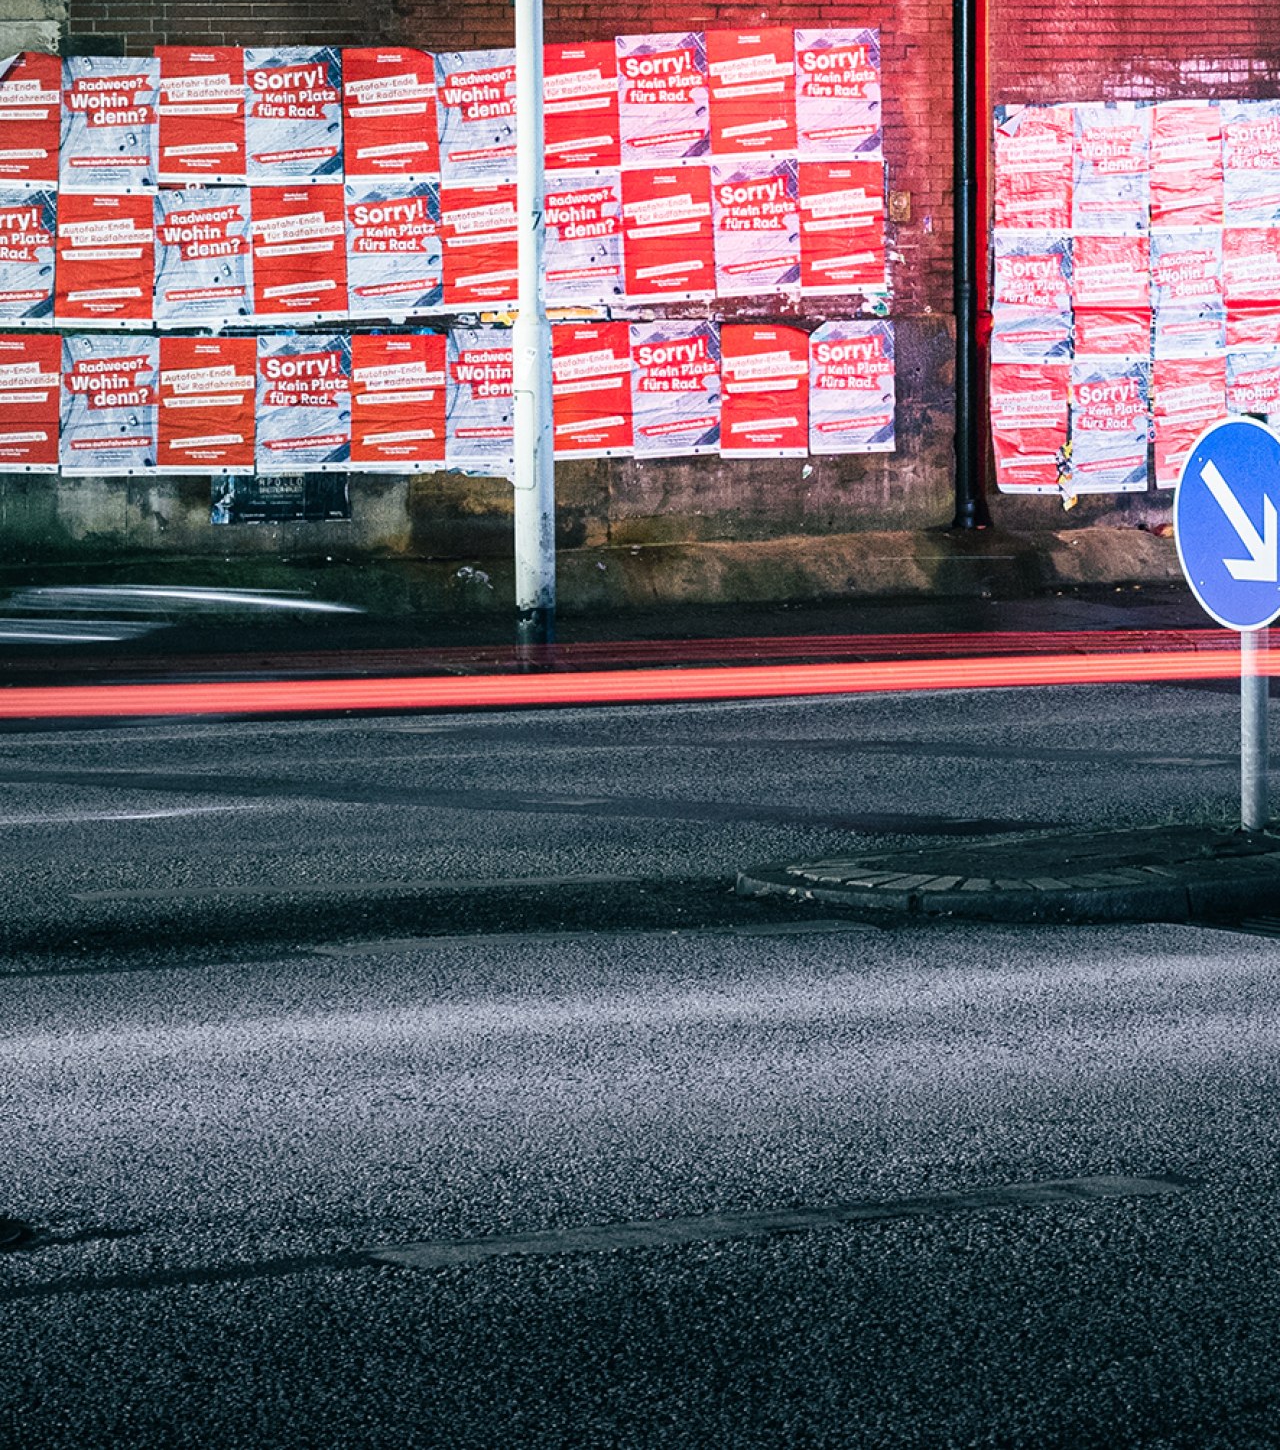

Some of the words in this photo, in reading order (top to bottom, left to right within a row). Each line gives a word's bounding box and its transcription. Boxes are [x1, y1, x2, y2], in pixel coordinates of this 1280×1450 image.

[626, 52, 691, 77] Sorry!
[804, 47, 865, 70] Sorry!
[79, 78, 143, 91] Radwege?
[254, 66, 324, 90] Sorry!
[452, 69, 512, 86] Radwege?
[637, 78, 666, 89] Kein
[668, 74, 702, 87] Platz
[814, 73, 841, 83] Kein
[843, 70, 876, 82] Platz
[265, 93, 296, 103] Kein
[299, 90, 336, 102] Platz
[445, 86, 499, 104] Wohin
[631, 89, 656, 102] fürs
[658, 89, 687, 102] Rad.
[808, 84, 831, 95] fürs
[834, 85, 861, 96] Rad.
[71, 94, 128, 108] Wohin
[467, 98, 516, 118] denn?
[93, 108, 148, 124] denn?
[258, 104, 285, 116] fürs
[288, 105, 319, 117] Rad.
[550, 190, 609, 206] Radwege?
[721, 179, 784, 204] Sorry!
[355, 200, 424, 225] Sorry!
[543, 206, 596, 224] Wohin
[732, 206, 760, 216] Kein
[762, 201, 795, 214] Platz
[0, 207, 38, 232] rry!
[171, 209, 234, 225] Radwege?
[531, 210, 543, 231] 7
[726, 217, 750, 229] fürs
[753, 216, 781, 229] Rad.
[11, 229, 50, 244] Platz
[164, 226, 220, 242] Wohin
[366, 227, 396, 237] Kein
[399, 223, 436, 235] Platz
[564, 219, 615, 238] denn?
[187, 238, 241, 257] denn?
[359, 238, 386, 250] fürs
[389, 238, 419, 250] Rad.
[1002, 258, 1057, 276] Sorry!
[464, 351, 512, 364] Radweg
[640, 339, 704, 365] Sorry!
[818, 339, 879, 362] Sorry!
[80, 358, 143, 373] Radwege?
[267, 354, 337, 378] Sorry!
[456, 364, 512, 381] Wohin
[650, 366, 679, 377] Kein
[681, 362, 715, 375] Platz
[828, 365, 855, 375] Kein
[857, 362, 889, 373] Platz
[72, 375, 129, 390] Wohin
[278, 381, 308, 391] Kein
[311, 378, 348, 390] Platz
[478, 380, 513, 397] den
[644, 378, 669, 390] fürs
[671, 377, 700, 390] Rad.
[821, 375, 845, 387] fürs
[847, 376, 874, 388] Rad.
[94, 388, 149, 406] denn?
[270, 392, 297, 403] fürs
[300, 393, 331, 405] Rad.
[1080, 381, 1135, 404] Sorry!
